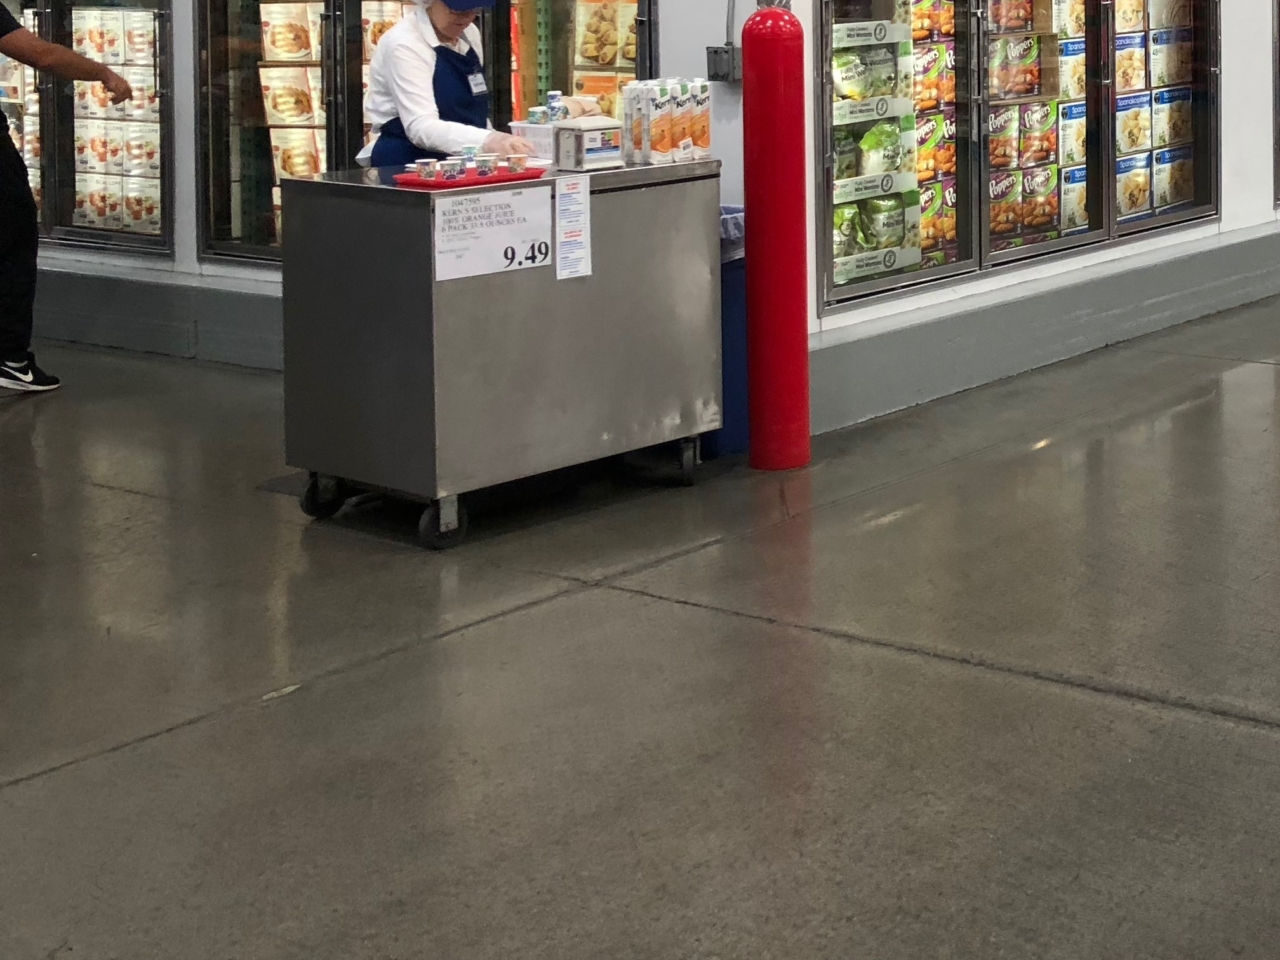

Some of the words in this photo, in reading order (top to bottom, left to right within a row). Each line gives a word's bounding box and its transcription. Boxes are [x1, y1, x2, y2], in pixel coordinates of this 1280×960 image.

[1006, 38, 1034, 61] Poppers
[989, 108, 1016, 132] Poppers
[1024, 104, 1051, 129] Poppers
[989, 174, 1017, 199] Poppers
[1024, 168, 1052, 194] Poppers
[462, 212, 494, 223] ORANGE
[495, 210, 515, 218] JUICE
[471, 203, 512, 214] SELECTION
[448, 224, 468, 232] PACK
[485, 218, 515, 228] OUNCES
[517, 216, 527, 224] EA
[503, 241, 550, 269] 9.49
